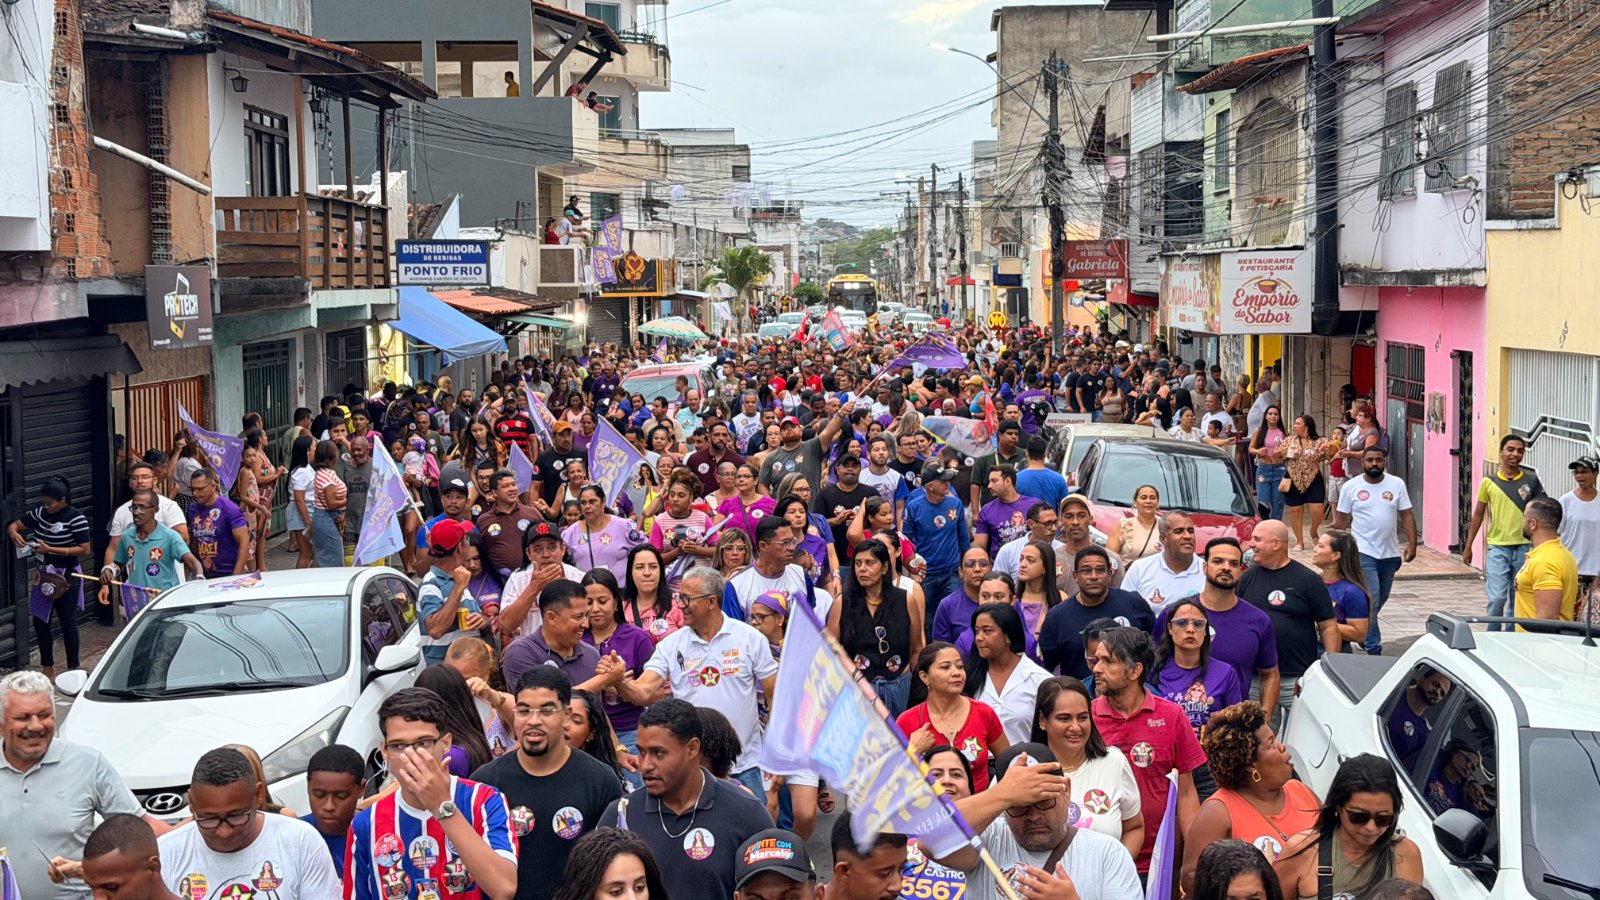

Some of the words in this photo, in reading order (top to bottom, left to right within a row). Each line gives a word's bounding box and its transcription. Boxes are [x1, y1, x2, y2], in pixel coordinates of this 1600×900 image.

[402, 244, 482, 254] DISTRIBUIDORA
[404, 266, 449, 276] PONTO
[452, 266, 483, 276] FRIO
[1067, 258, 1120, 273] Gabriela
[164, 294, 199, 317] PROTECH
[1232, 288, 1301, 311] Empório
[1234, 309, 1246, 318] do
[1244, 306, 1293, 324] Sabor
[197, 440, 226, 455] ASTRO
[776, 840, 792, 849] COM
[750, 849, 794, 862] Marcelo
[454, 863, 463, 872] 13
[389, 873, 399, 883] 13
[924, 868, 966, 880] CASTRO
